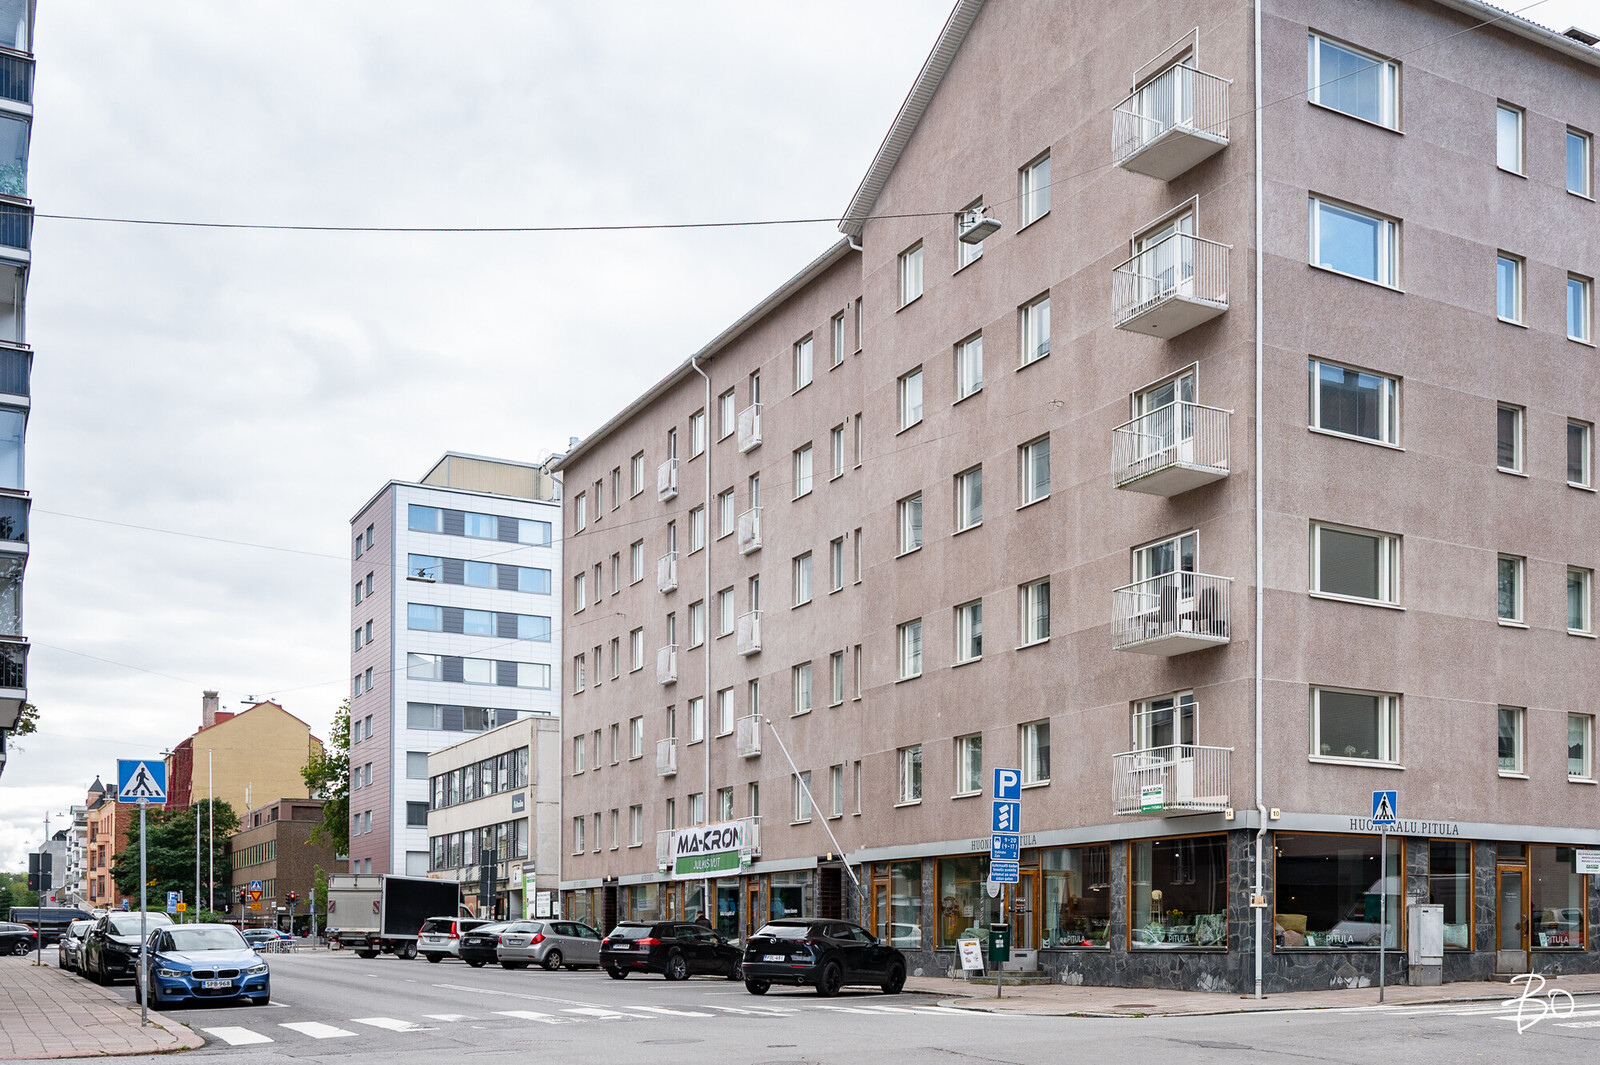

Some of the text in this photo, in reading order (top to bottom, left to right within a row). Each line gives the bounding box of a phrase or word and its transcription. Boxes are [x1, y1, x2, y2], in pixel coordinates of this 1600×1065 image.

[999, 770, 1018, 797] P
[1350, 818, 1459, 836] HUOKALU.PITULA
[1168, 934, 1190, 943] PITULA
[1325, 934, 1354, 943] PITULA
